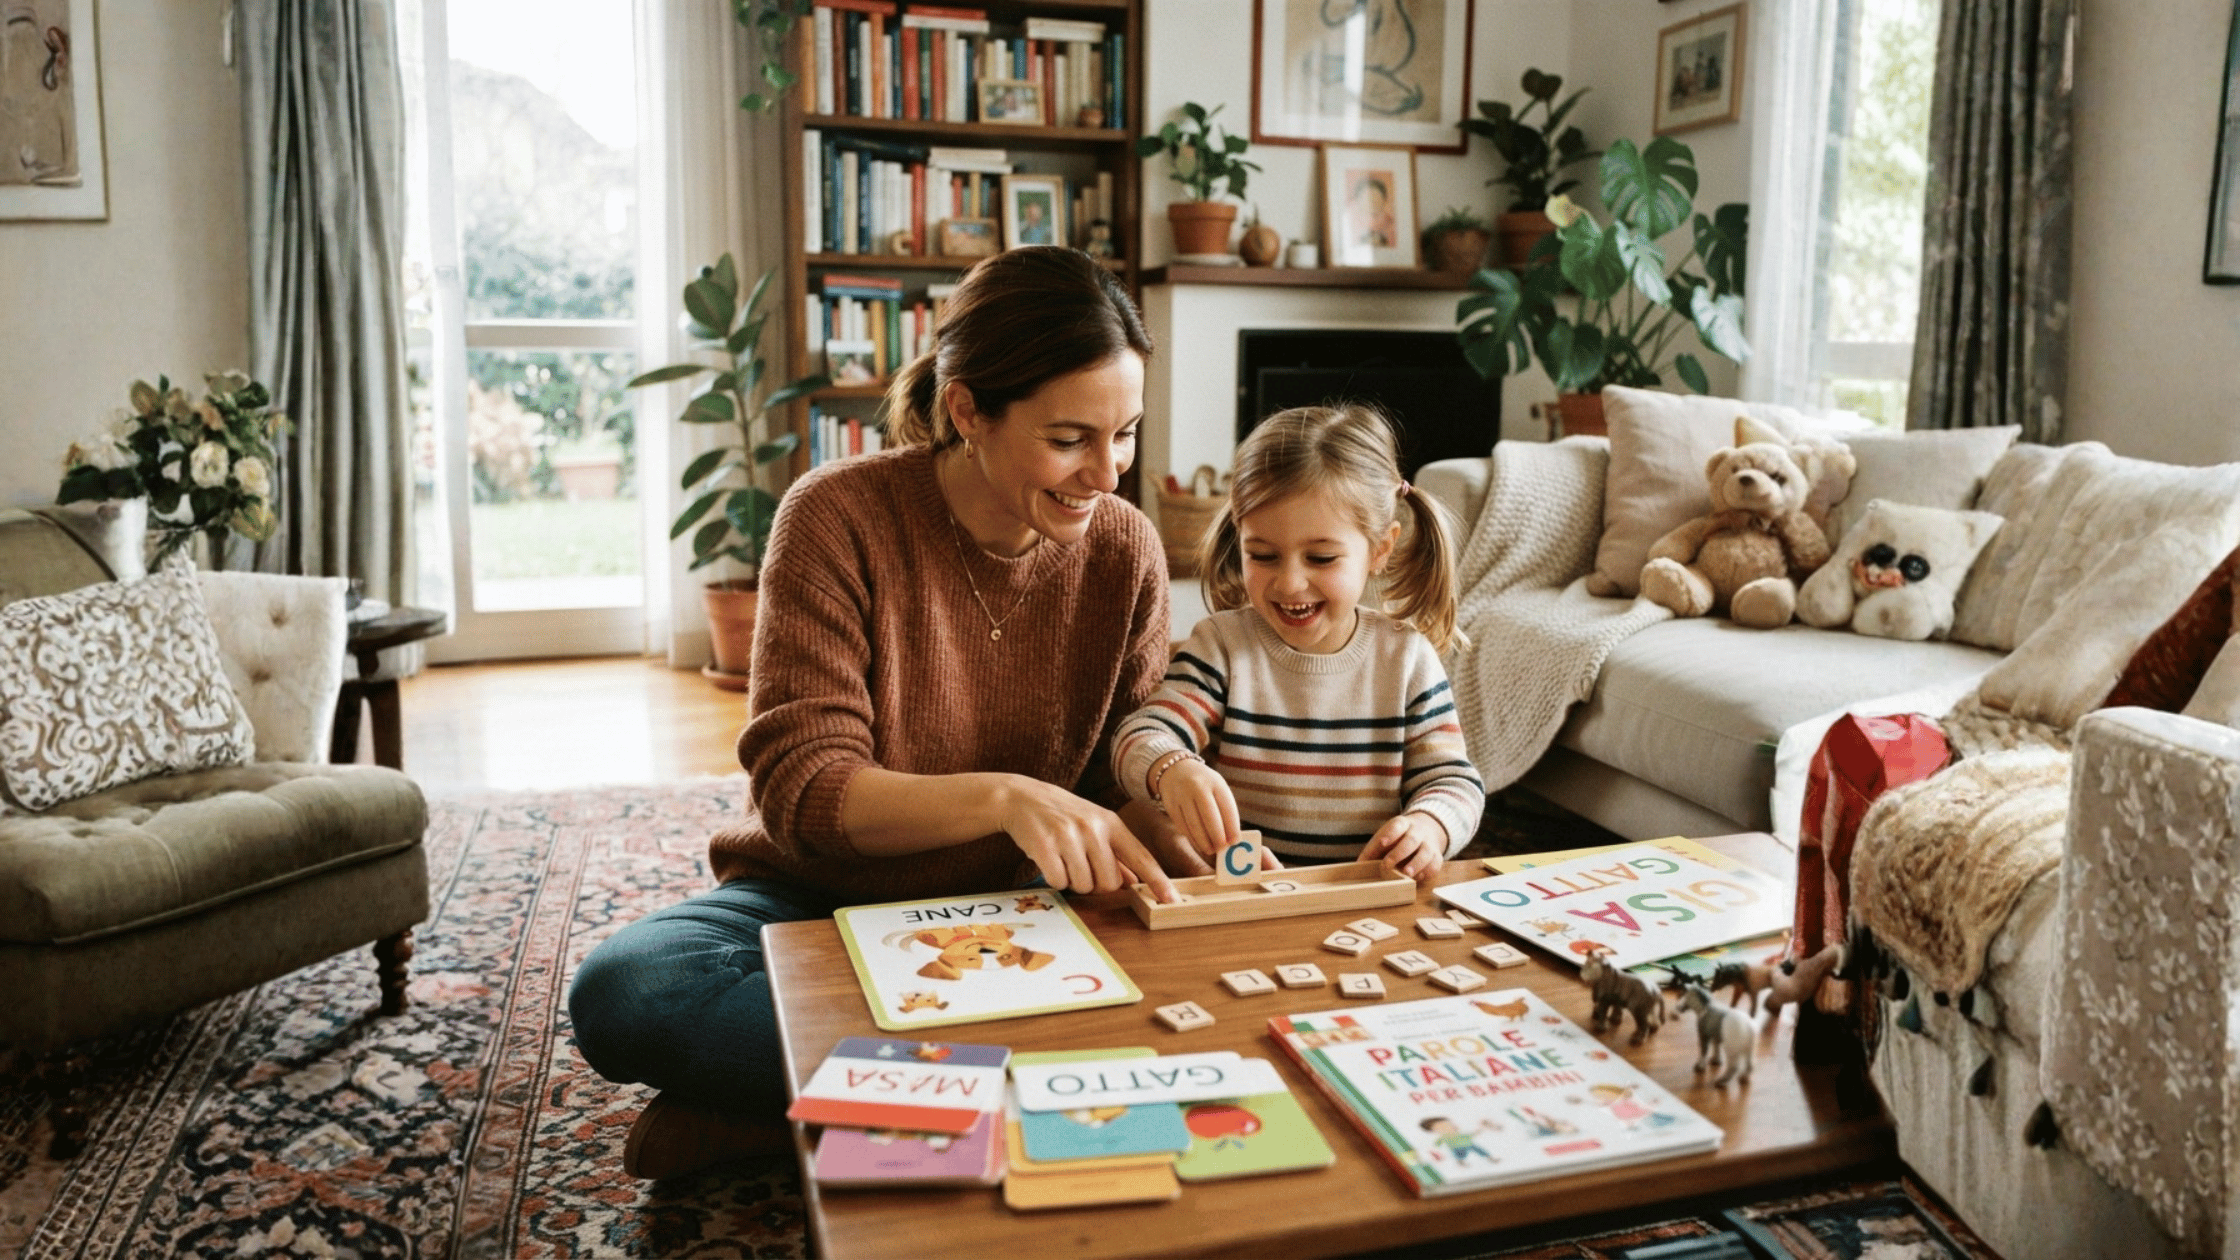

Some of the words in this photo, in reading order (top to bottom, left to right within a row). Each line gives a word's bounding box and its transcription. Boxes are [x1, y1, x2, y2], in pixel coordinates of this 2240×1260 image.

[1225, 842, 1254, 876] C
[1480, 857, 1680, 908] GATTO
[902, 902, 1002, 923] CANE
[1565, 879, 1760, 932] GISA
[1062, 974, 1103, 994] C
[1367, 1029, 1537, 1066] PAROLE
[1047, 1065, 1224, 1096] GATTO
[1376, 1048, 1574, 1091] ITALIANE
[1408, 1087, 1464, 1106] PER
